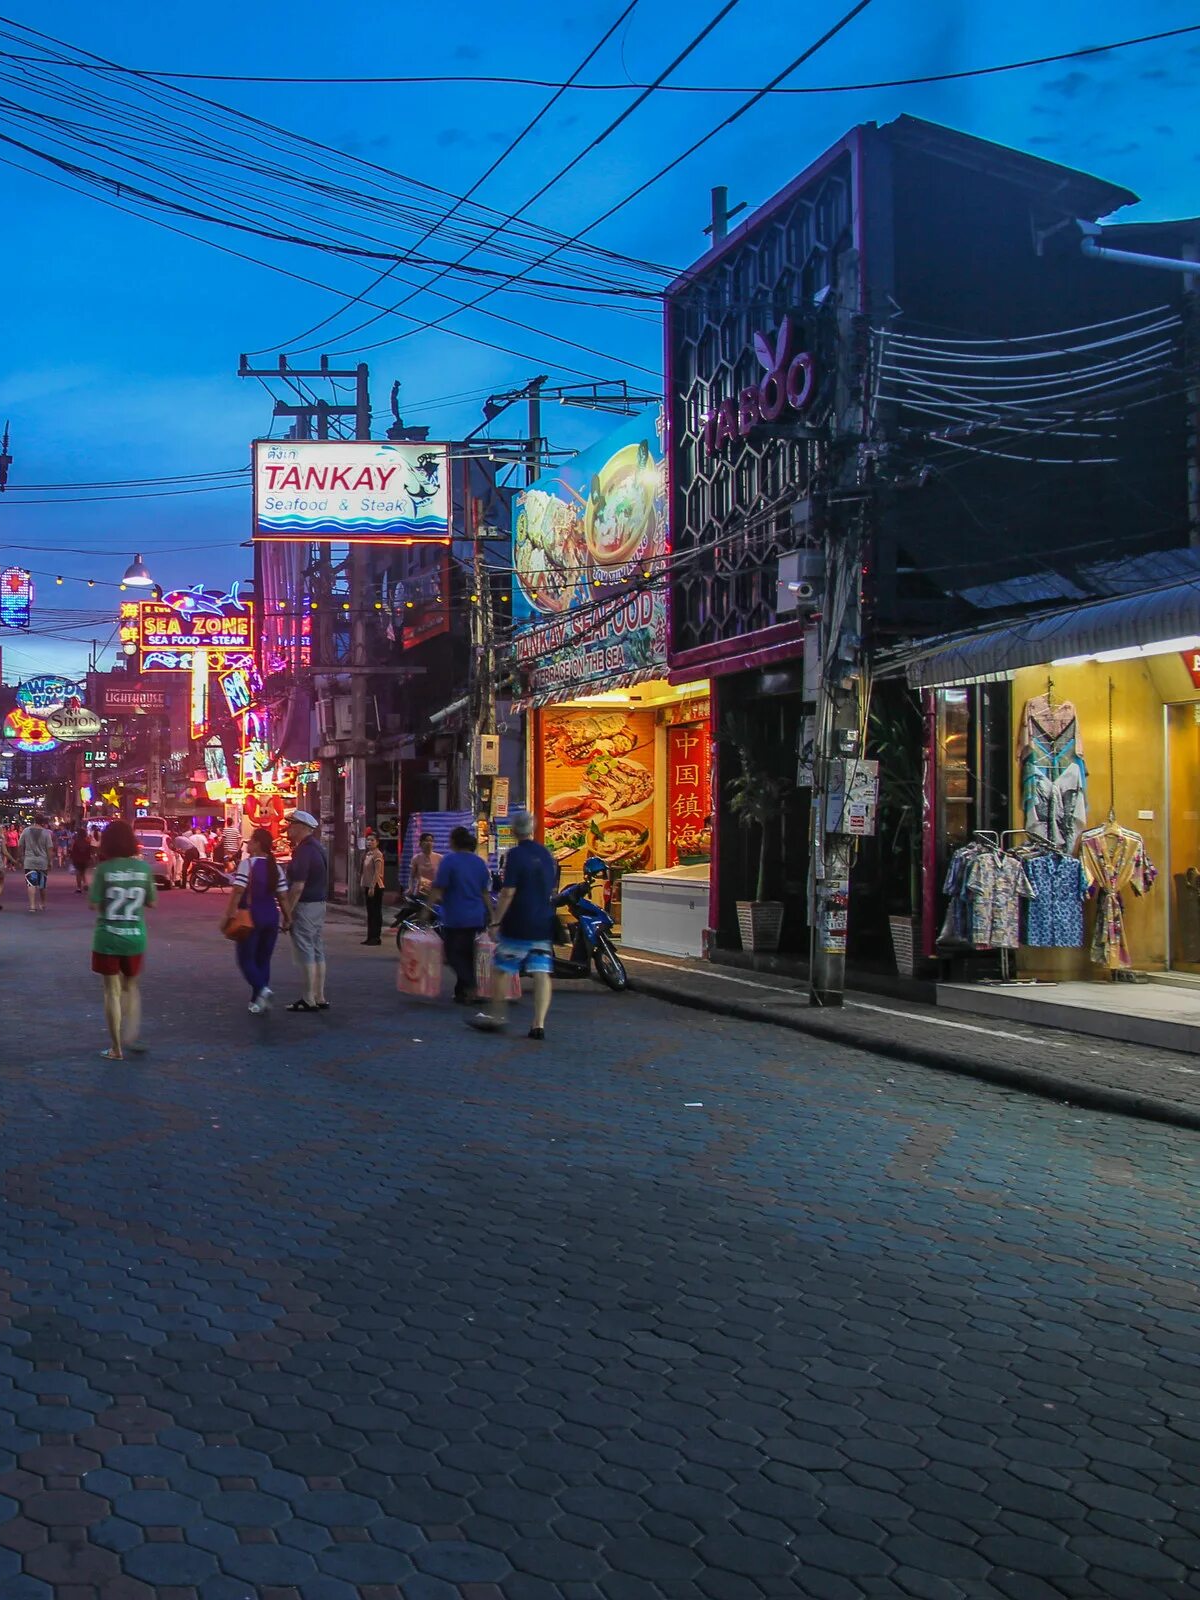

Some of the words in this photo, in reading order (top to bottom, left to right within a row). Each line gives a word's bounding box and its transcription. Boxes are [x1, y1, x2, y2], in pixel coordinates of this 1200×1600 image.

[699, 352, 815, 457] TABOO
[265, 466, 396, 491] TANKAY
[265, 497, 328, 511] Seafood
[339, 499, 349, 511] &
[360, 499, 404, 512] Steak
[144, 617, 182, 635] SEA
[192, 617, 249, 635] ZONE
[515, 622, 567, 661] TANKAY
[571, 590, 654, 649] SEAFOOD
[148, 635, 169, 645] SEA
[171, 635, 200, 645] FOOD
[211, 636, 245, 645] STEAK
[572, 658, 584, 678] ON
[586, 650, 604, 673] THE
[606, 645, 624, 669] SEA
[105, 692, 164, 703] LIGHTHOUSE
[51, 714, 98, 730] SIMON
[104, 887, 147, 921] 22
